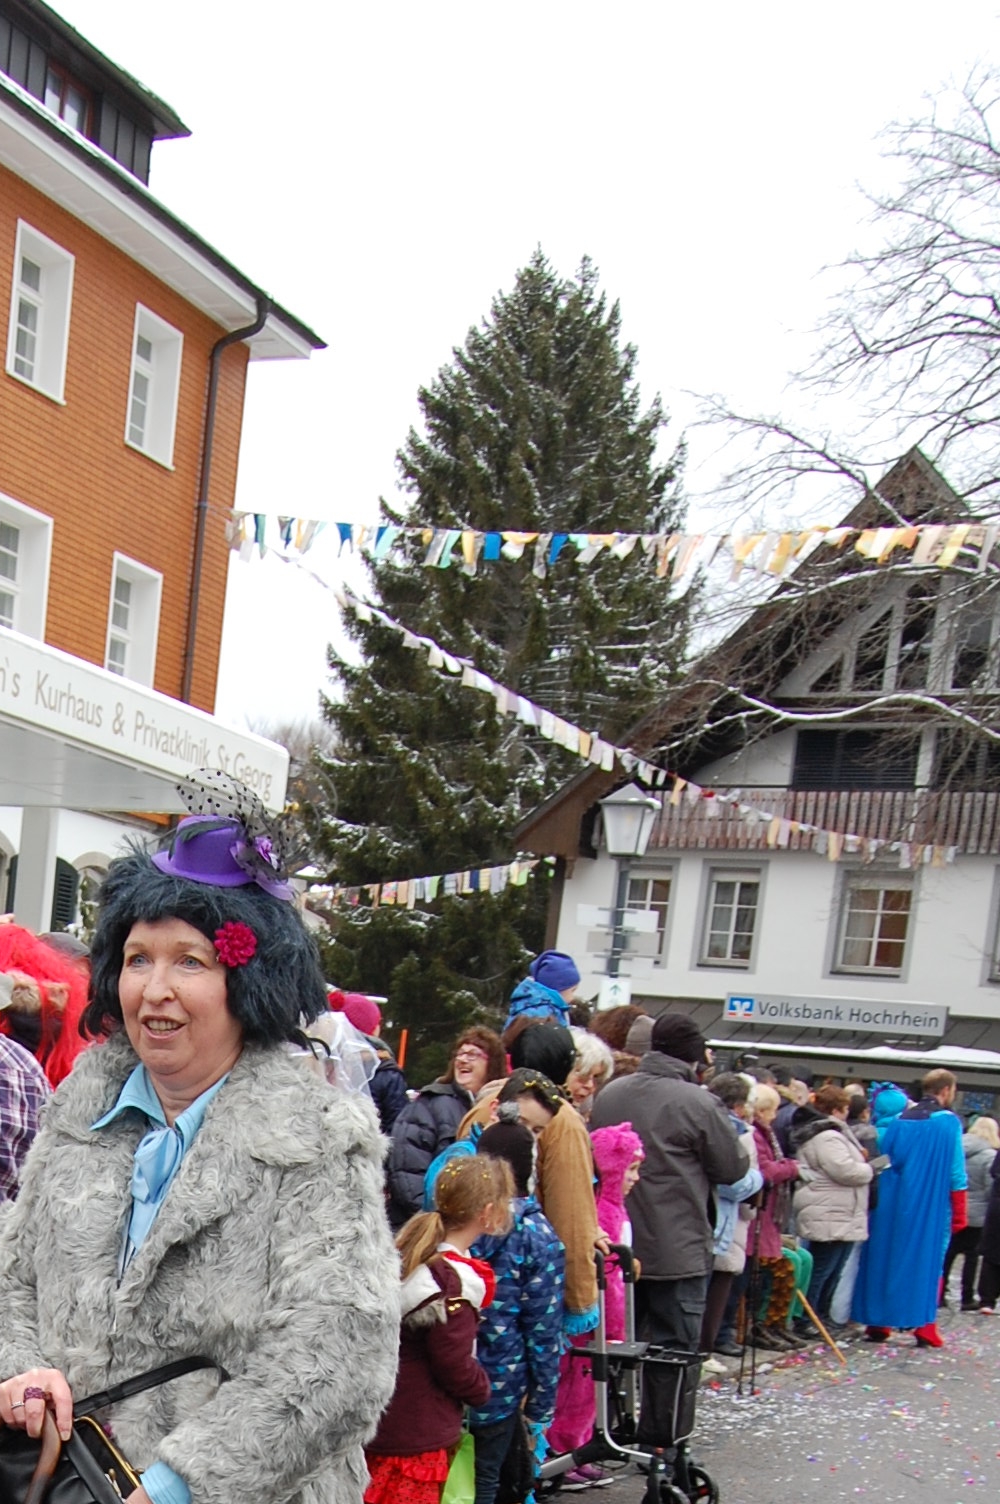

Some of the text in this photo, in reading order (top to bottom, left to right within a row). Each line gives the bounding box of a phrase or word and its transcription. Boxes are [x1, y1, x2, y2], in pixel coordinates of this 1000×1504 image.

[34, 669, 103, 728] Kurhaus
[112, 702, 126, 737] &
[133, 710, 211, 770] Privatklinik
[233, 752, 273, 802] Georg
[758, 1001, 940, 1028] Volksbank Hochrhein
